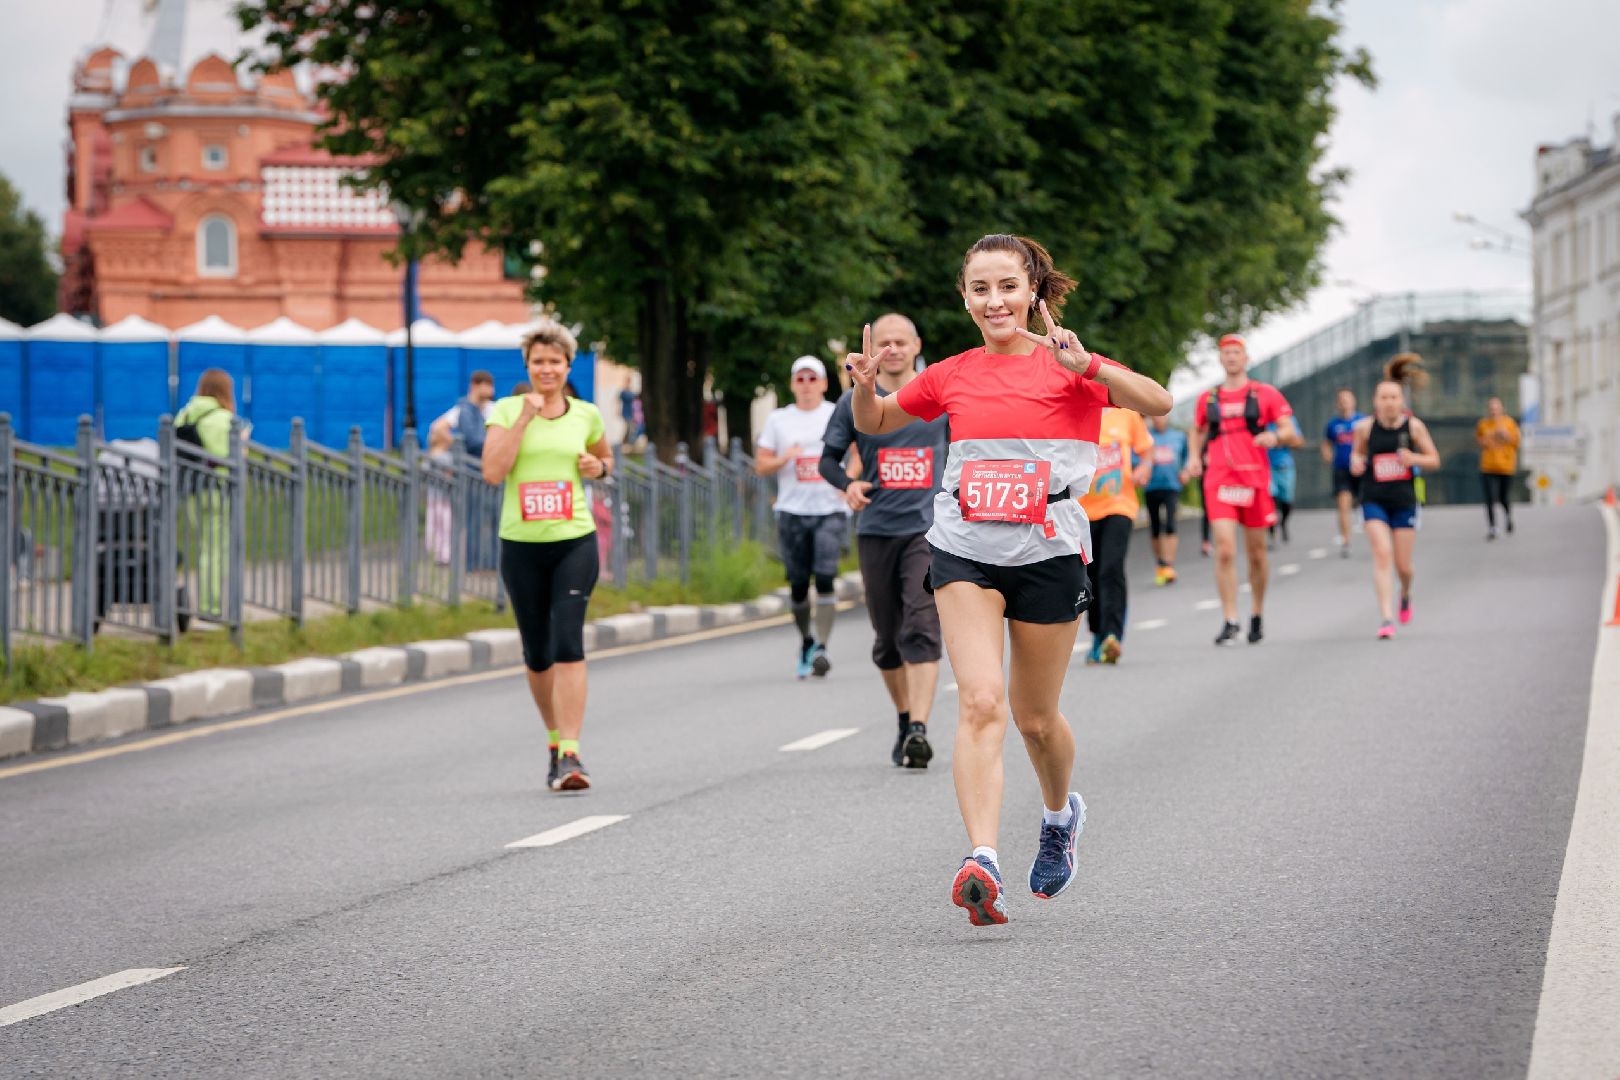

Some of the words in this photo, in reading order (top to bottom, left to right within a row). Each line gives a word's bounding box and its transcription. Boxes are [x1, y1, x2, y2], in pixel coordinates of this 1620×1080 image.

[880, 462, 925, 481] 5053
[524, 494, 563, 513] 5181
[967, 481, 1029, 510] 5173
